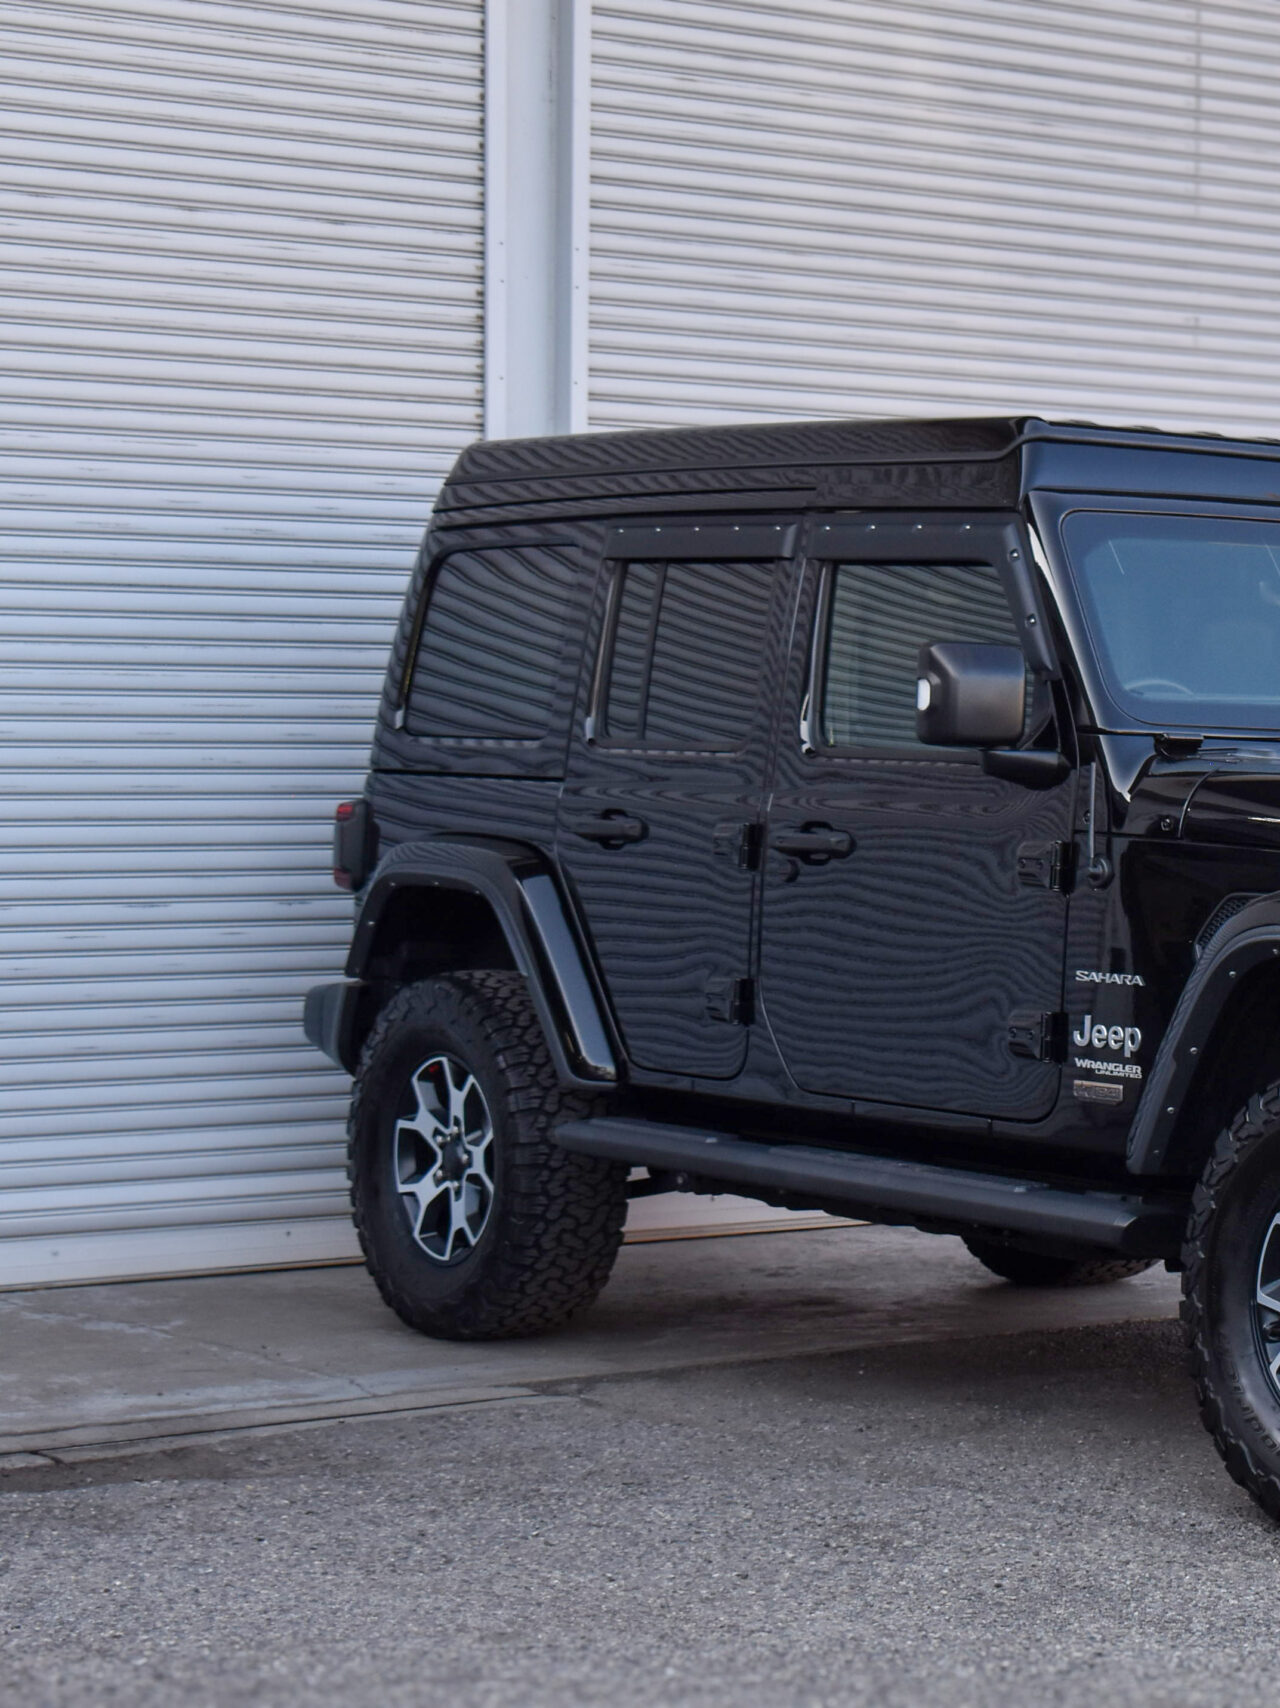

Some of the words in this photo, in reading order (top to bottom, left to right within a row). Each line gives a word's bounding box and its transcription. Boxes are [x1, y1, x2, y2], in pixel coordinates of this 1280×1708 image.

[1075, 970, 1146, 987] SAHARA
[1073, 1014, 1142, 1058] Jeep
[1074, 1057, 1142, 1074] WRANGLER
[1095, 1068, 1142, 1079] UNLIMITED
